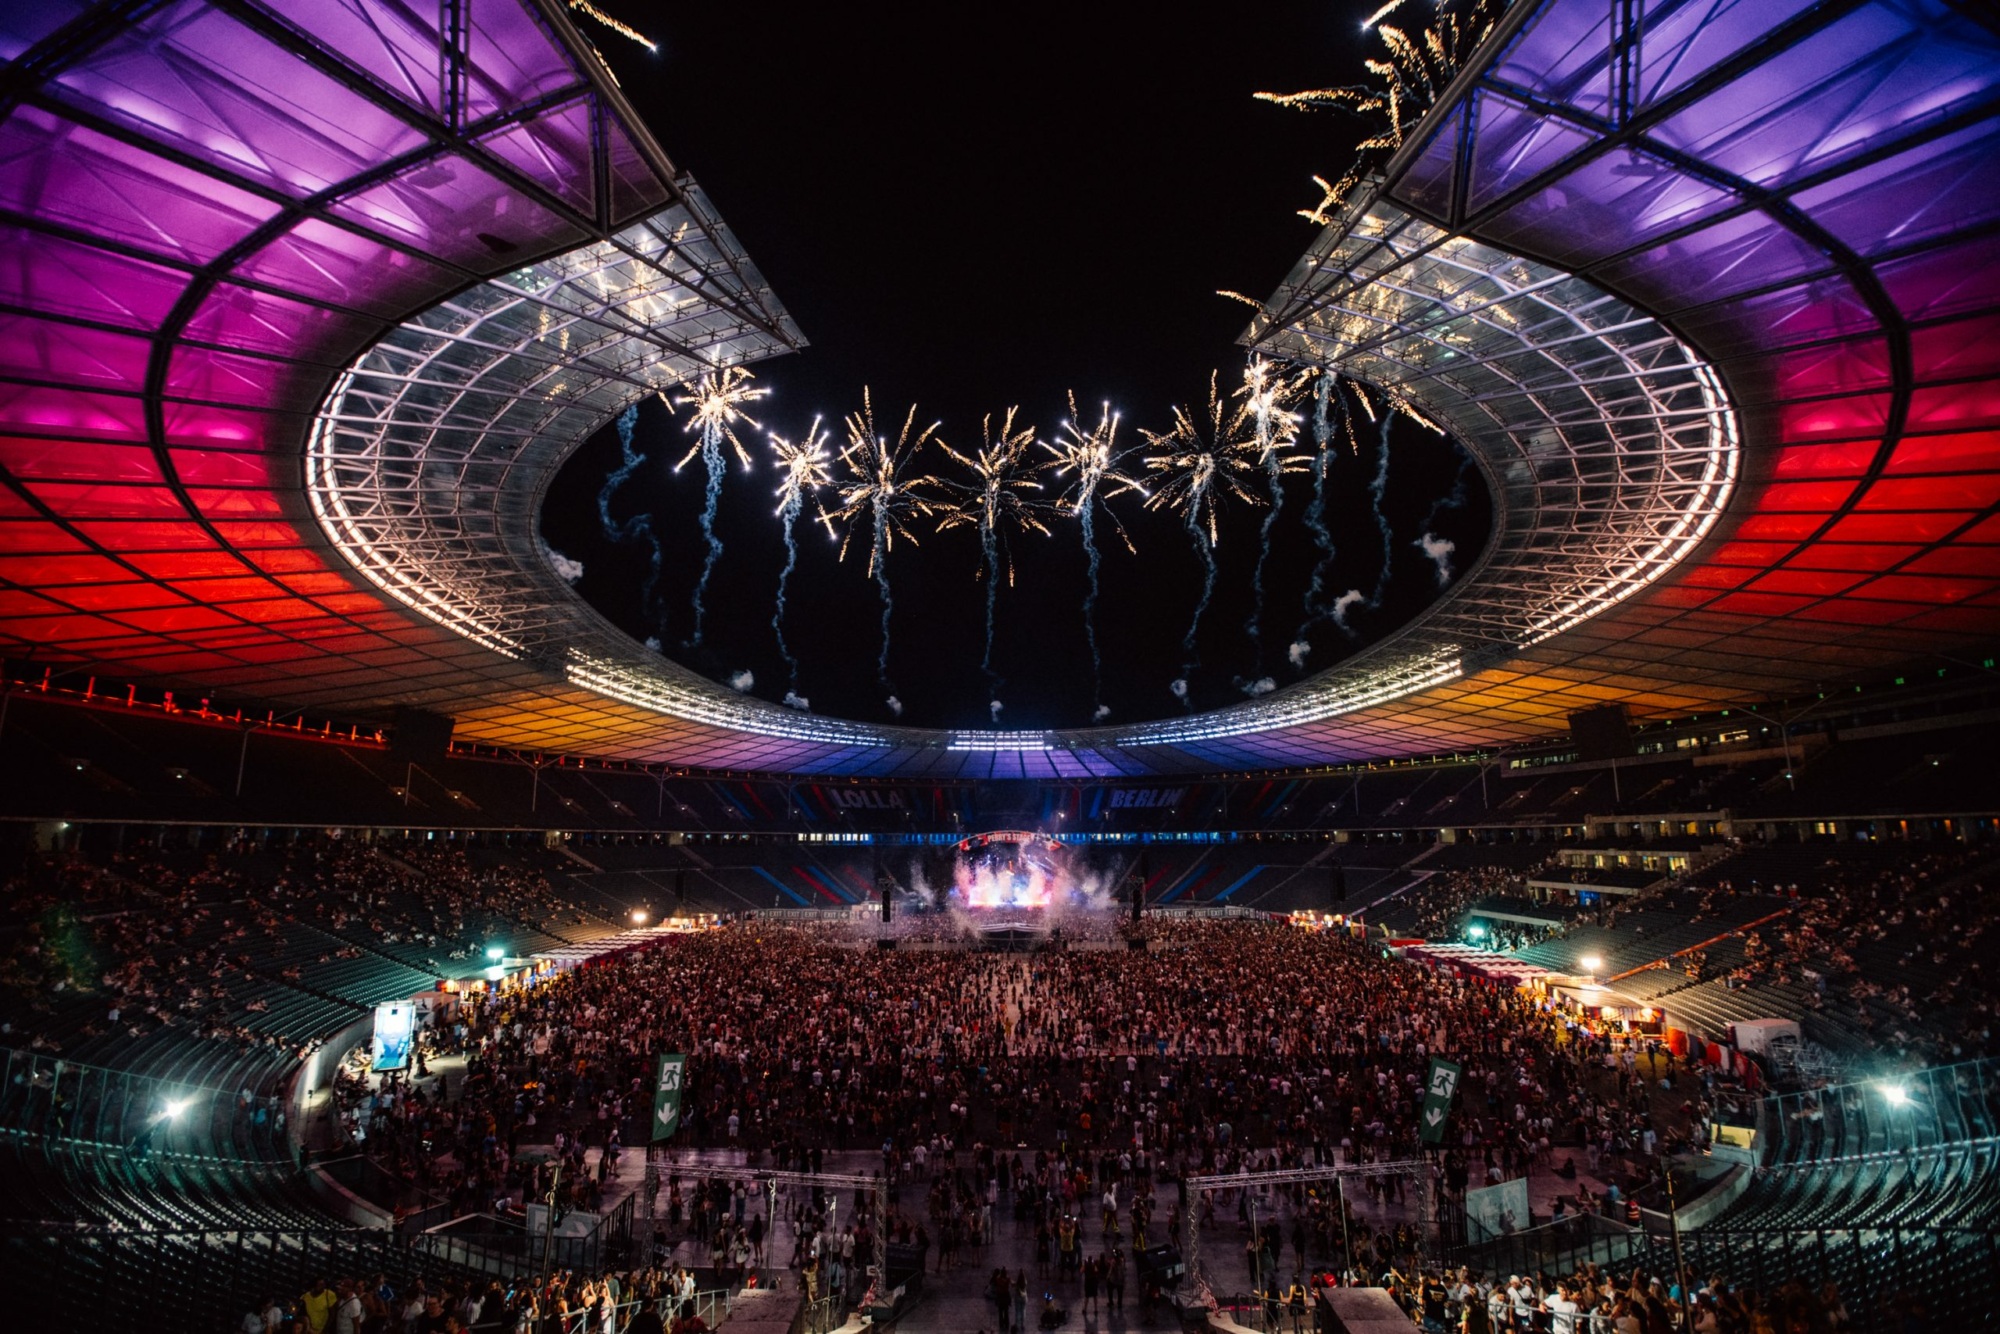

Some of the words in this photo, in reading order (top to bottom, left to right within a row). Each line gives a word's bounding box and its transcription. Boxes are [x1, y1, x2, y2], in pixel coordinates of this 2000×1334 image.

[830, 788, 905, 809] LOLLA
[1110, 788, 1183, 808] BERLIN
[823, 911, 837, 919] EXIT
[1210, 909, 1224, 917] EXIT
[1228, 908, 1241, 916] EXIT
